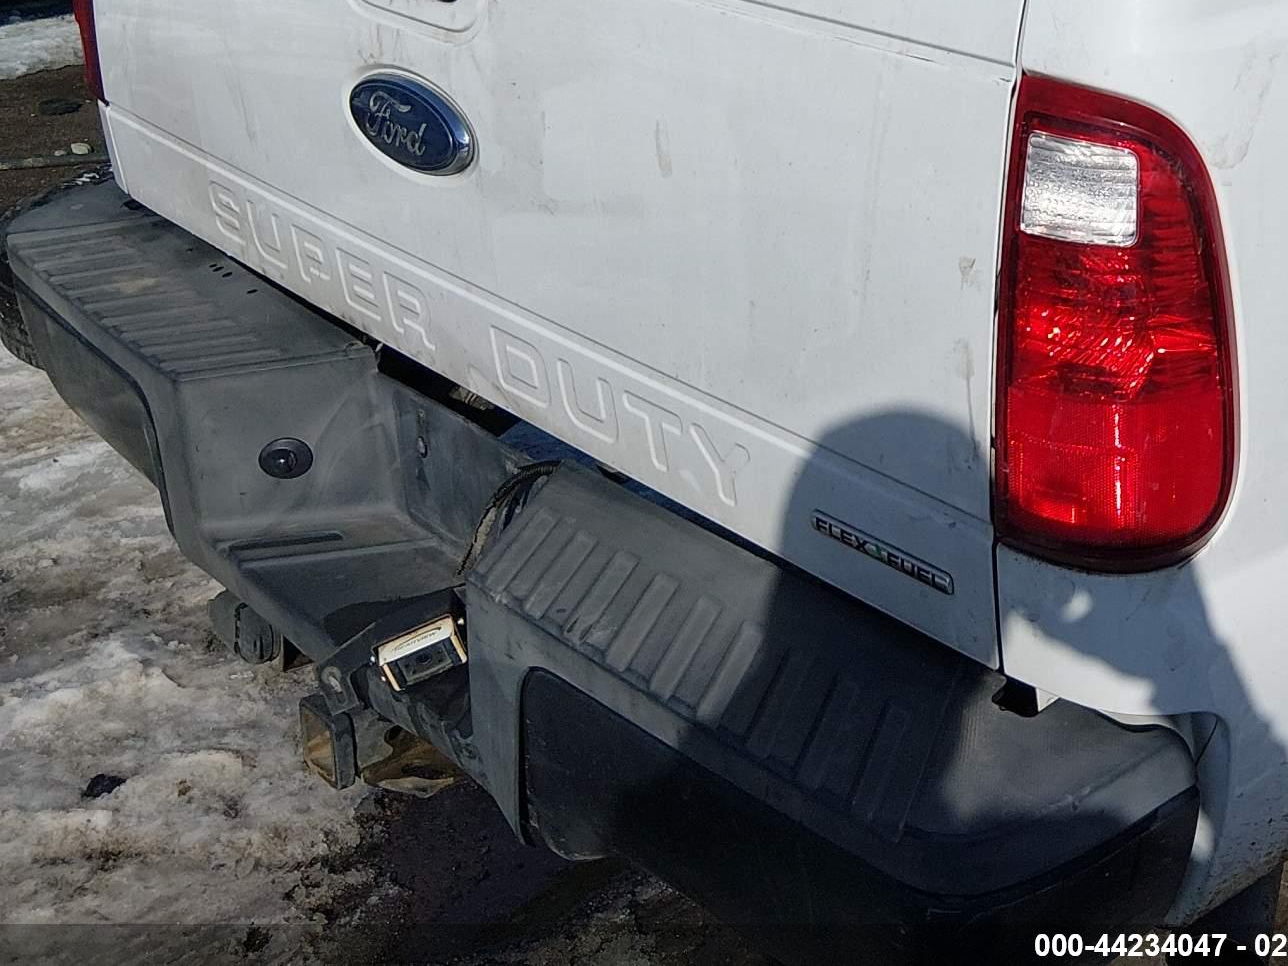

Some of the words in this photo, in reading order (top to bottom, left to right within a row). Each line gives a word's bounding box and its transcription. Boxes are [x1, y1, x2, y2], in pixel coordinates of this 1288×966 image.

[366, 90, 428, 156] Ford
[208, 179, 437, 352] SUPER
[488, 324, 751, 507] DUTY
[815, 516, 868, 554] FLEX
[886, 551, 952, 595] FUEL
